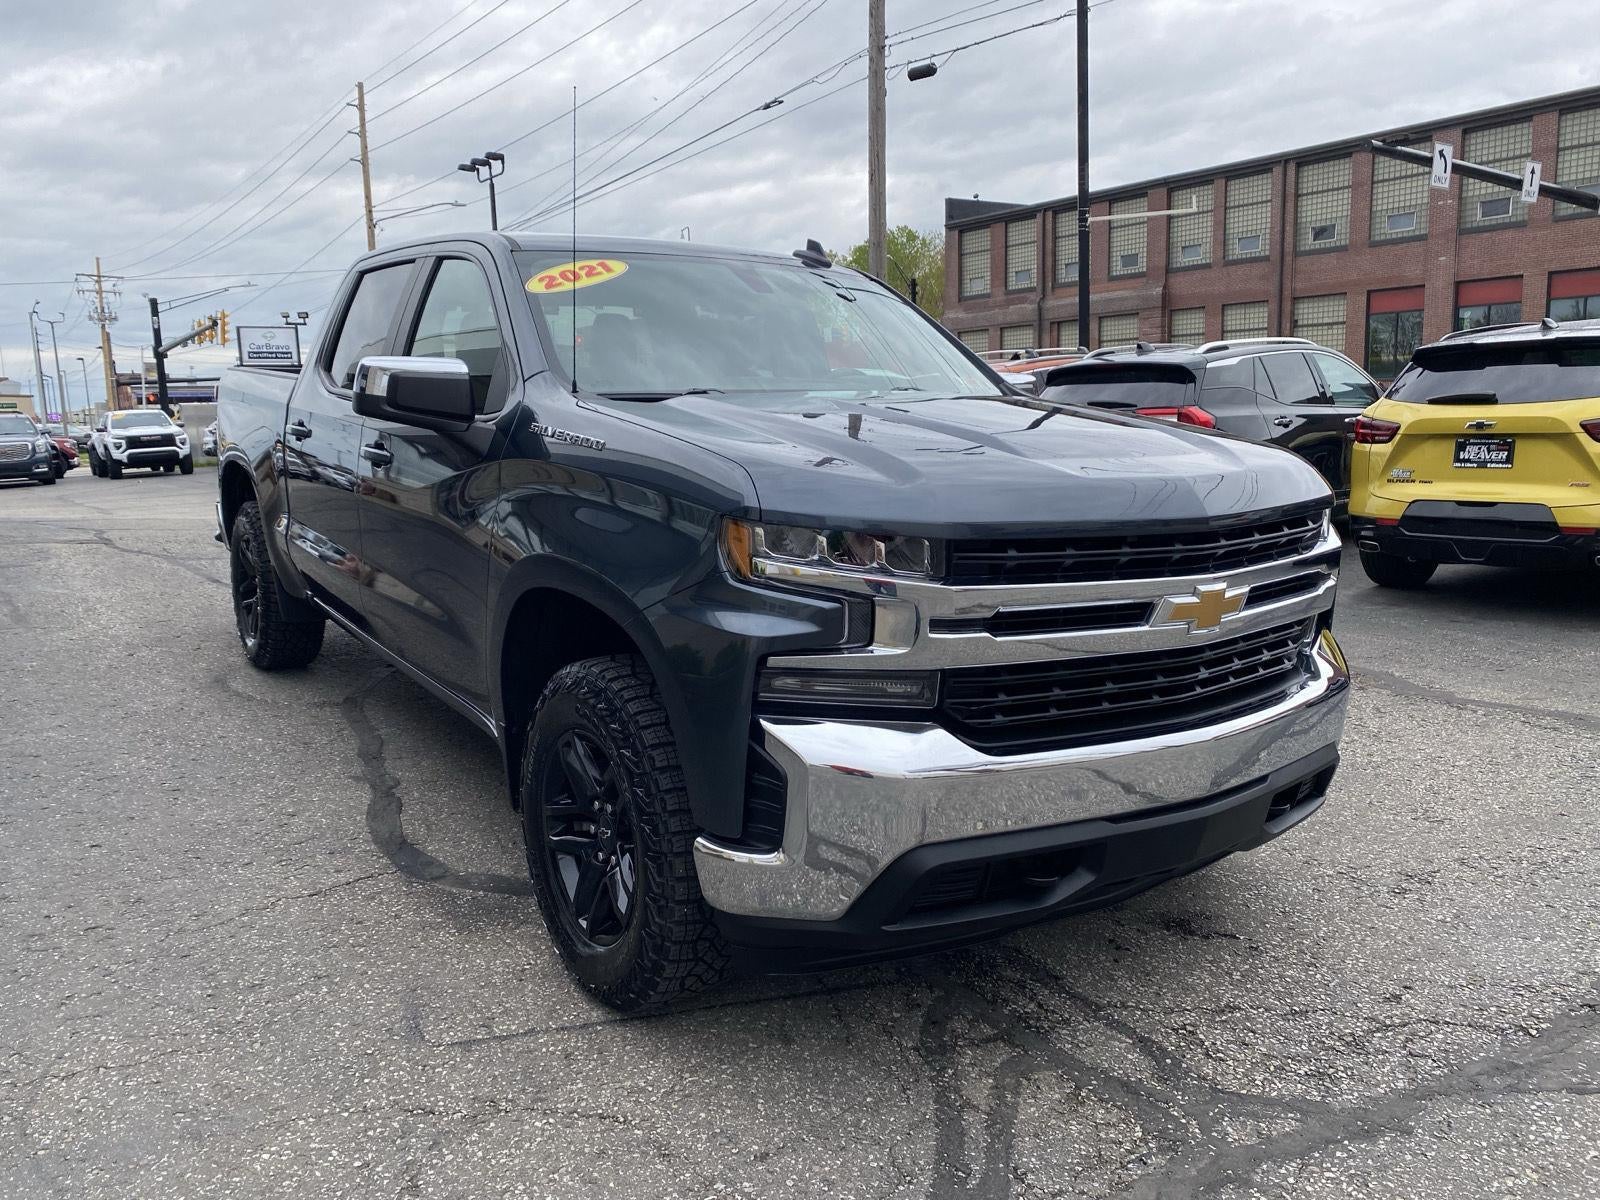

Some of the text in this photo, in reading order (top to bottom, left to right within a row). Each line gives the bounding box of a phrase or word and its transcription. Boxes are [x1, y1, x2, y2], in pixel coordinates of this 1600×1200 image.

[1433, 175, 1448, 184] ONLY
[1524, 189, 1536, 198] ONLY
[538, 261, 616, 290] 2021
[249, 342, 290, 351] CarBravo
[529, 422, 606, 451] SILVERADO
[1465, 445, 1488, 453] RICK
[1459, 451, 1508, 460] WEAVER
